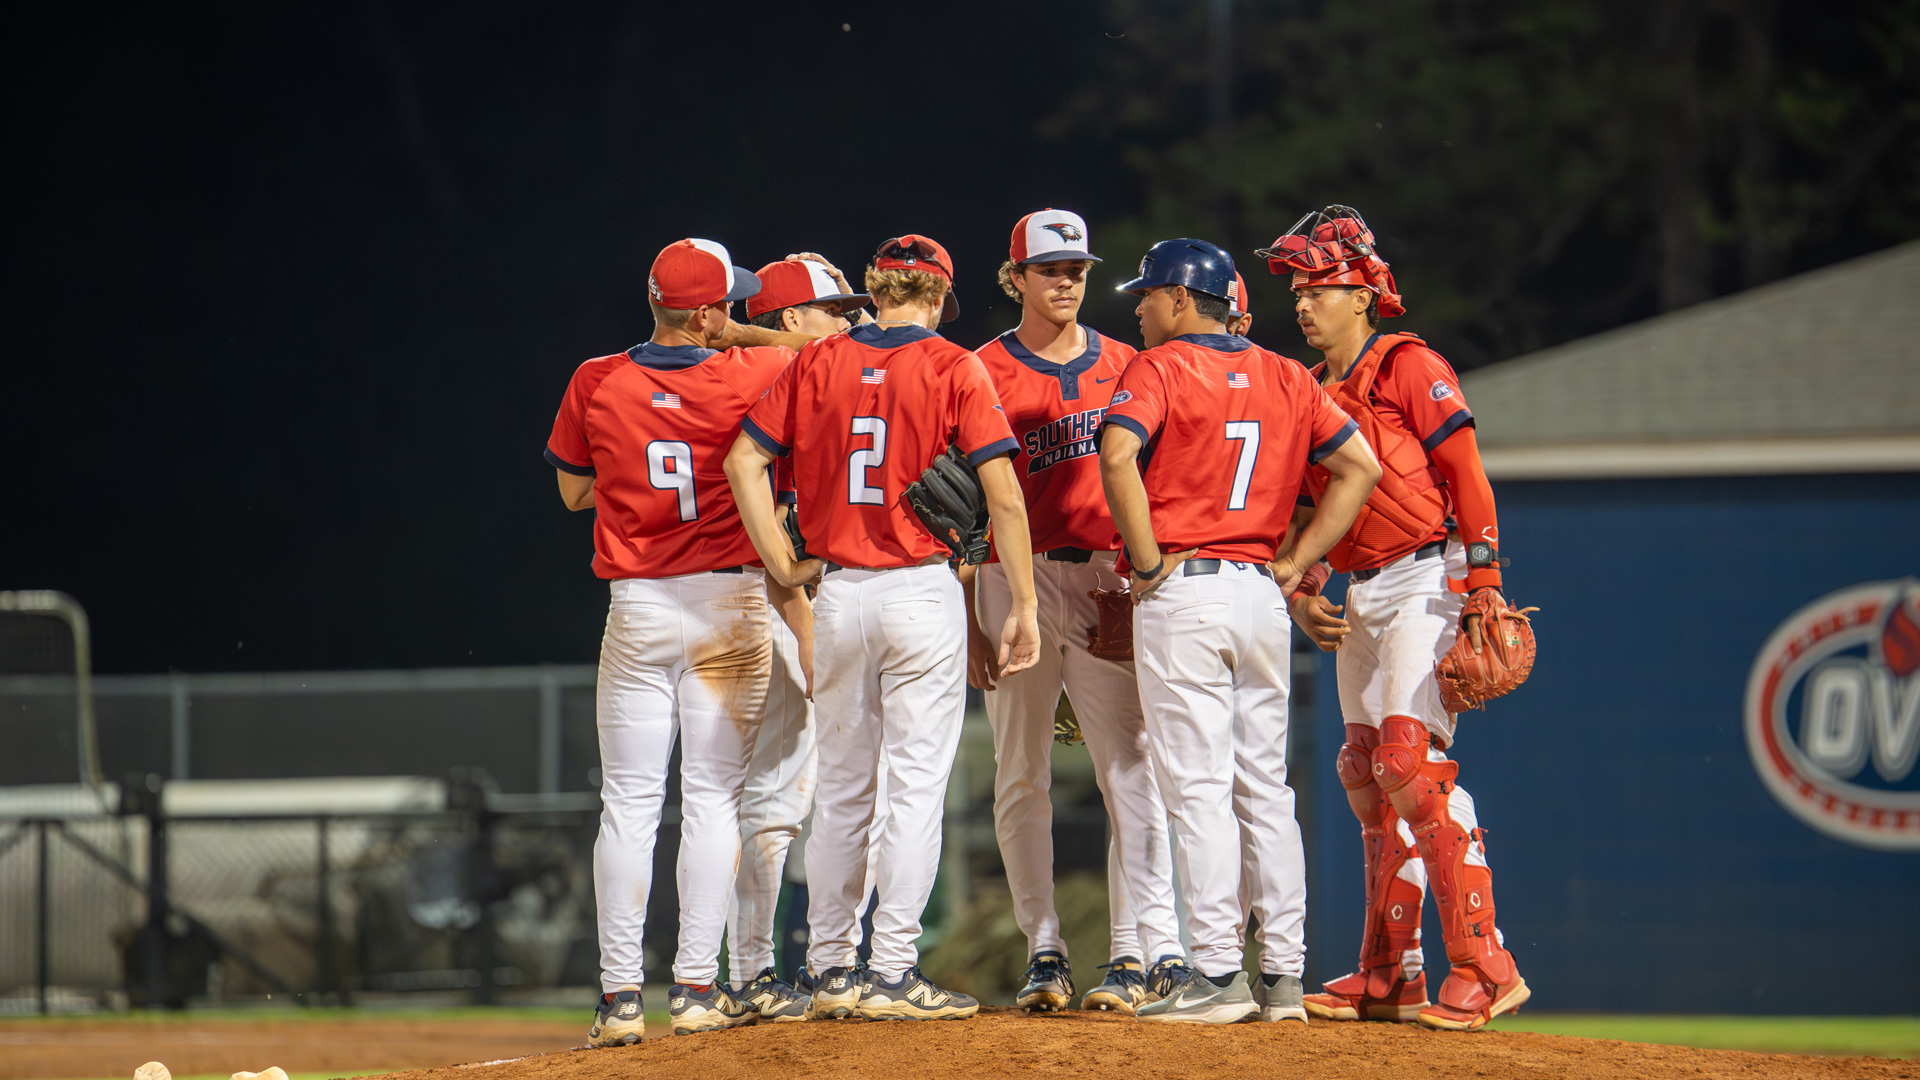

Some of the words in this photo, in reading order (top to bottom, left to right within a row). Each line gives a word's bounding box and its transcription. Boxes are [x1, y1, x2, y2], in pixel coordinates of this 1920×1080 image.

[645, 439, 699, 523] 9
[848, 416, 887, 507] 2
[1040, 442, 1098, 468] INDIANA
[1225, 420, 1261, 511] 7
